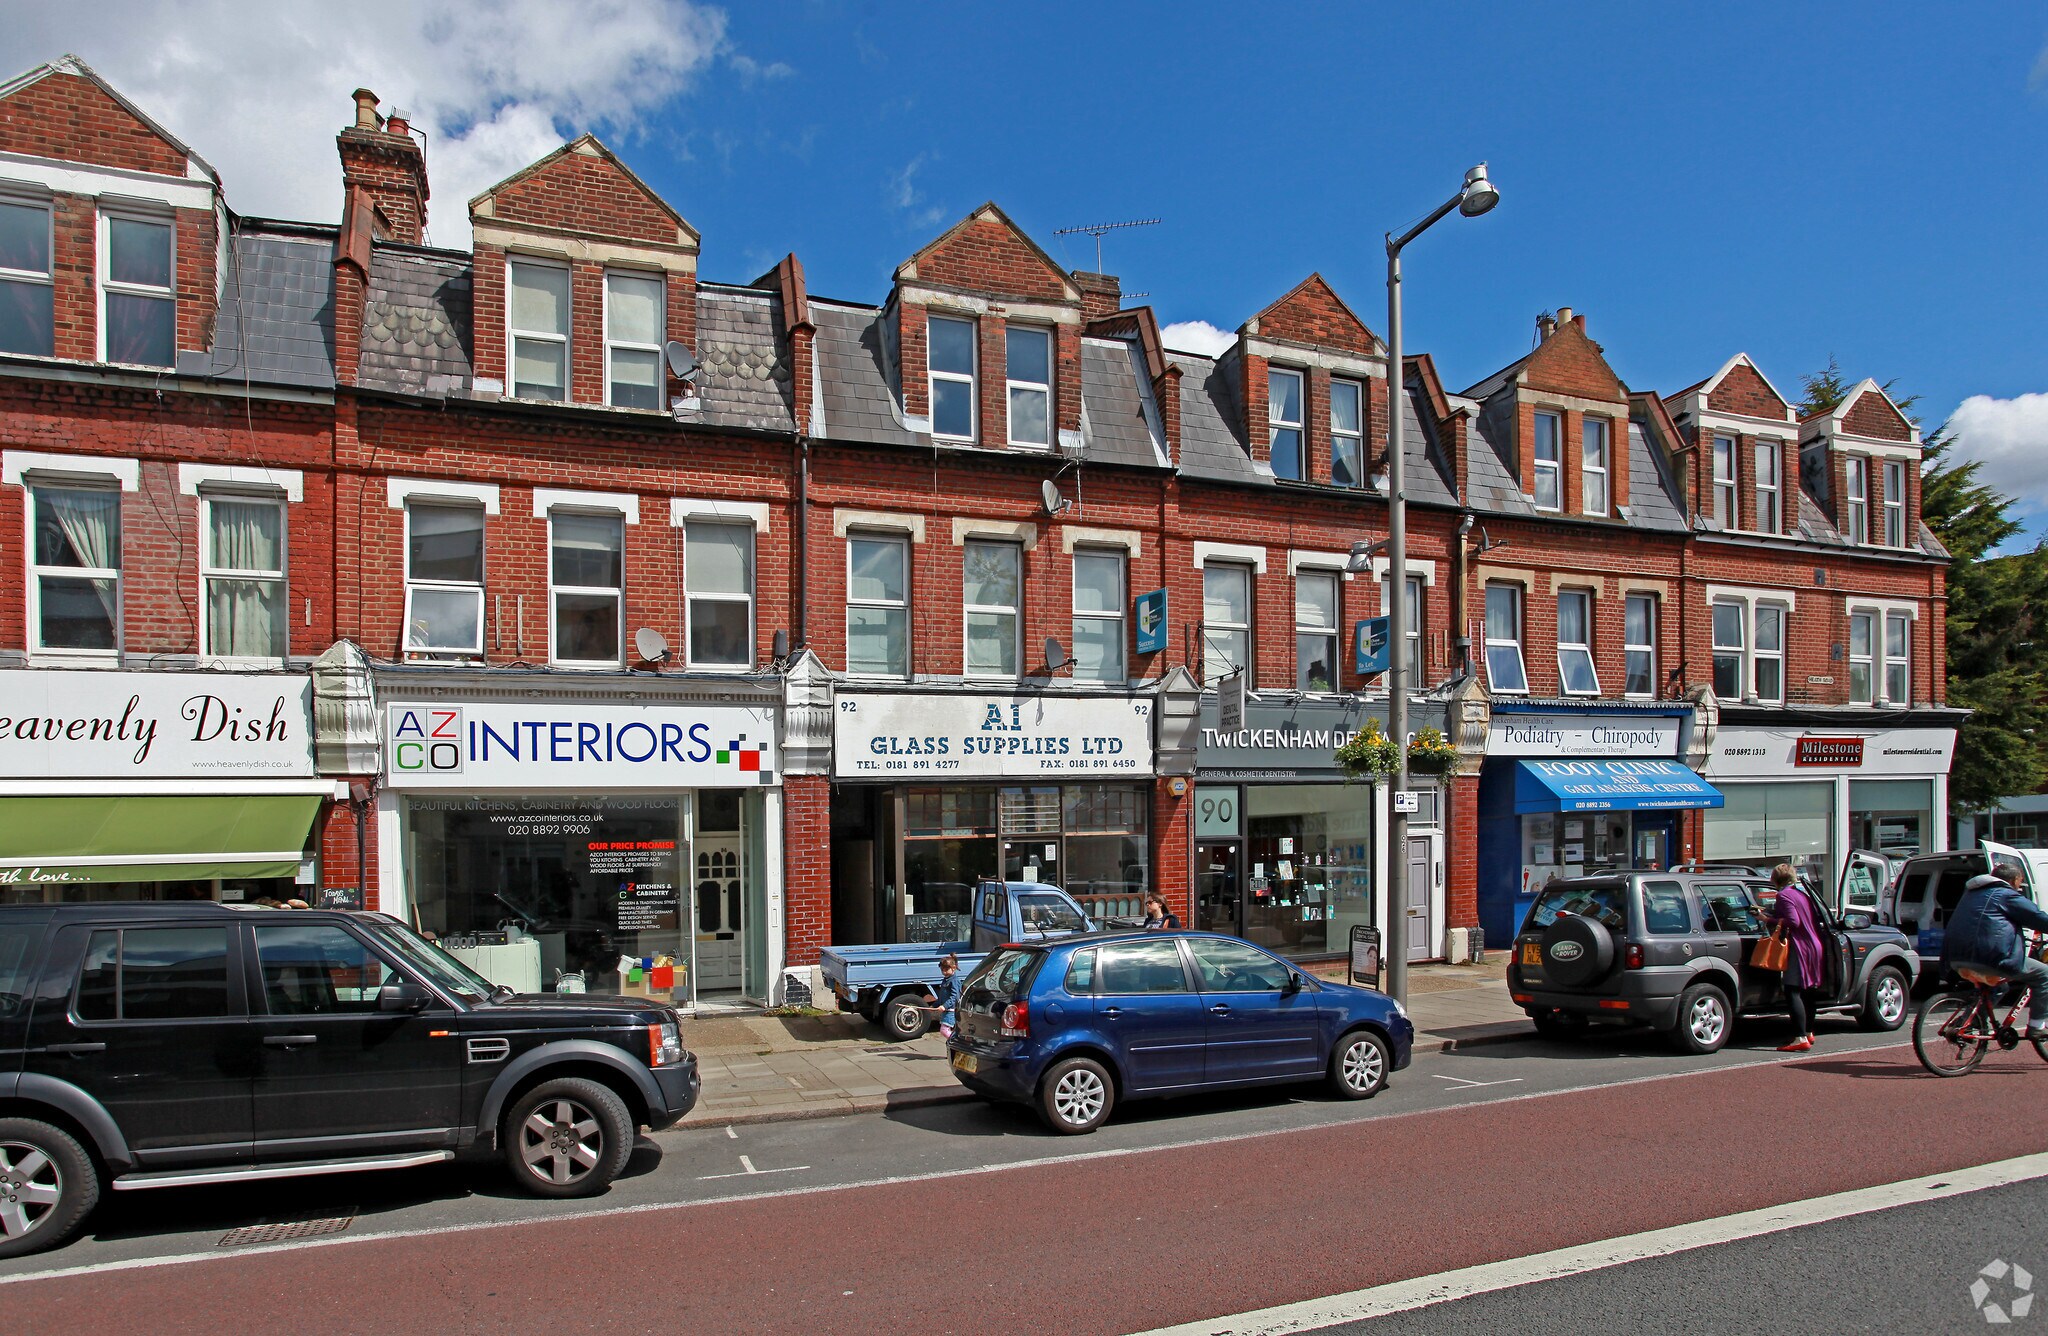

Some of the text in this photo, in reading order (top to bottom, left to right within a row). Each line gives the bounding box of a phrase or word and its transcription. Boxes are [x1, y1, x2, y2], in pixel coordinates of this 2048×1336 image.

[840, 701, 857, 712] 92
[1134, 705, 1148, 715] 92
[181, 695, 289, 742] Dish
[1523, 717, 1540, 725] Health
[469, 720, 712, 763] INTERIORS
[1202, 728, 1329, 749] TWICKENHAM
[1504, 725, 1565, 748] Podiatry
[1591, 726, 1663, 749] Chiropody
[870, 736, 1123, 755] GLASS SUPPLIES LTD
[1566, 746, 1605, 755] Complementary
[1607, 746, 1627, 754] Therapy
[1801, 741, 1861, 755] Milestone
[192, 760, 294, 769] www.heavenlydish.co.uk
[857, 761, 959, 769] TEL: 0181 891 4277
[1069, 760, 1088, 768] 0181
[1093, 760, 1108, 768] 891
[1113, 760, 1135, 768] 6450
[1534, 761, 1681, 777] FOOT CLINIC
[1200, 770, 1228, 778] GENERAL
[1612, 775, 1639, 785] AND
[1563, 783, 1704, 794] GAIT ANALYSIS CENTRE
[464, 800, 518, 811] KITCHENS,
[521, 800, 576, 810] CABINETRY
[580, 800, 604, 810] AND
[606, 799, 642, 810] WOOD
[1201, 798, 1233, 823] 90
[489, 812, 605, 823] www.azcointeriors.co.uk
[508, 824, 591, 836] 020 8892 9906
[588, 841, 675, 850] OUR PRICE PROMISE
[907, 914, 957, 930] MIRROR
